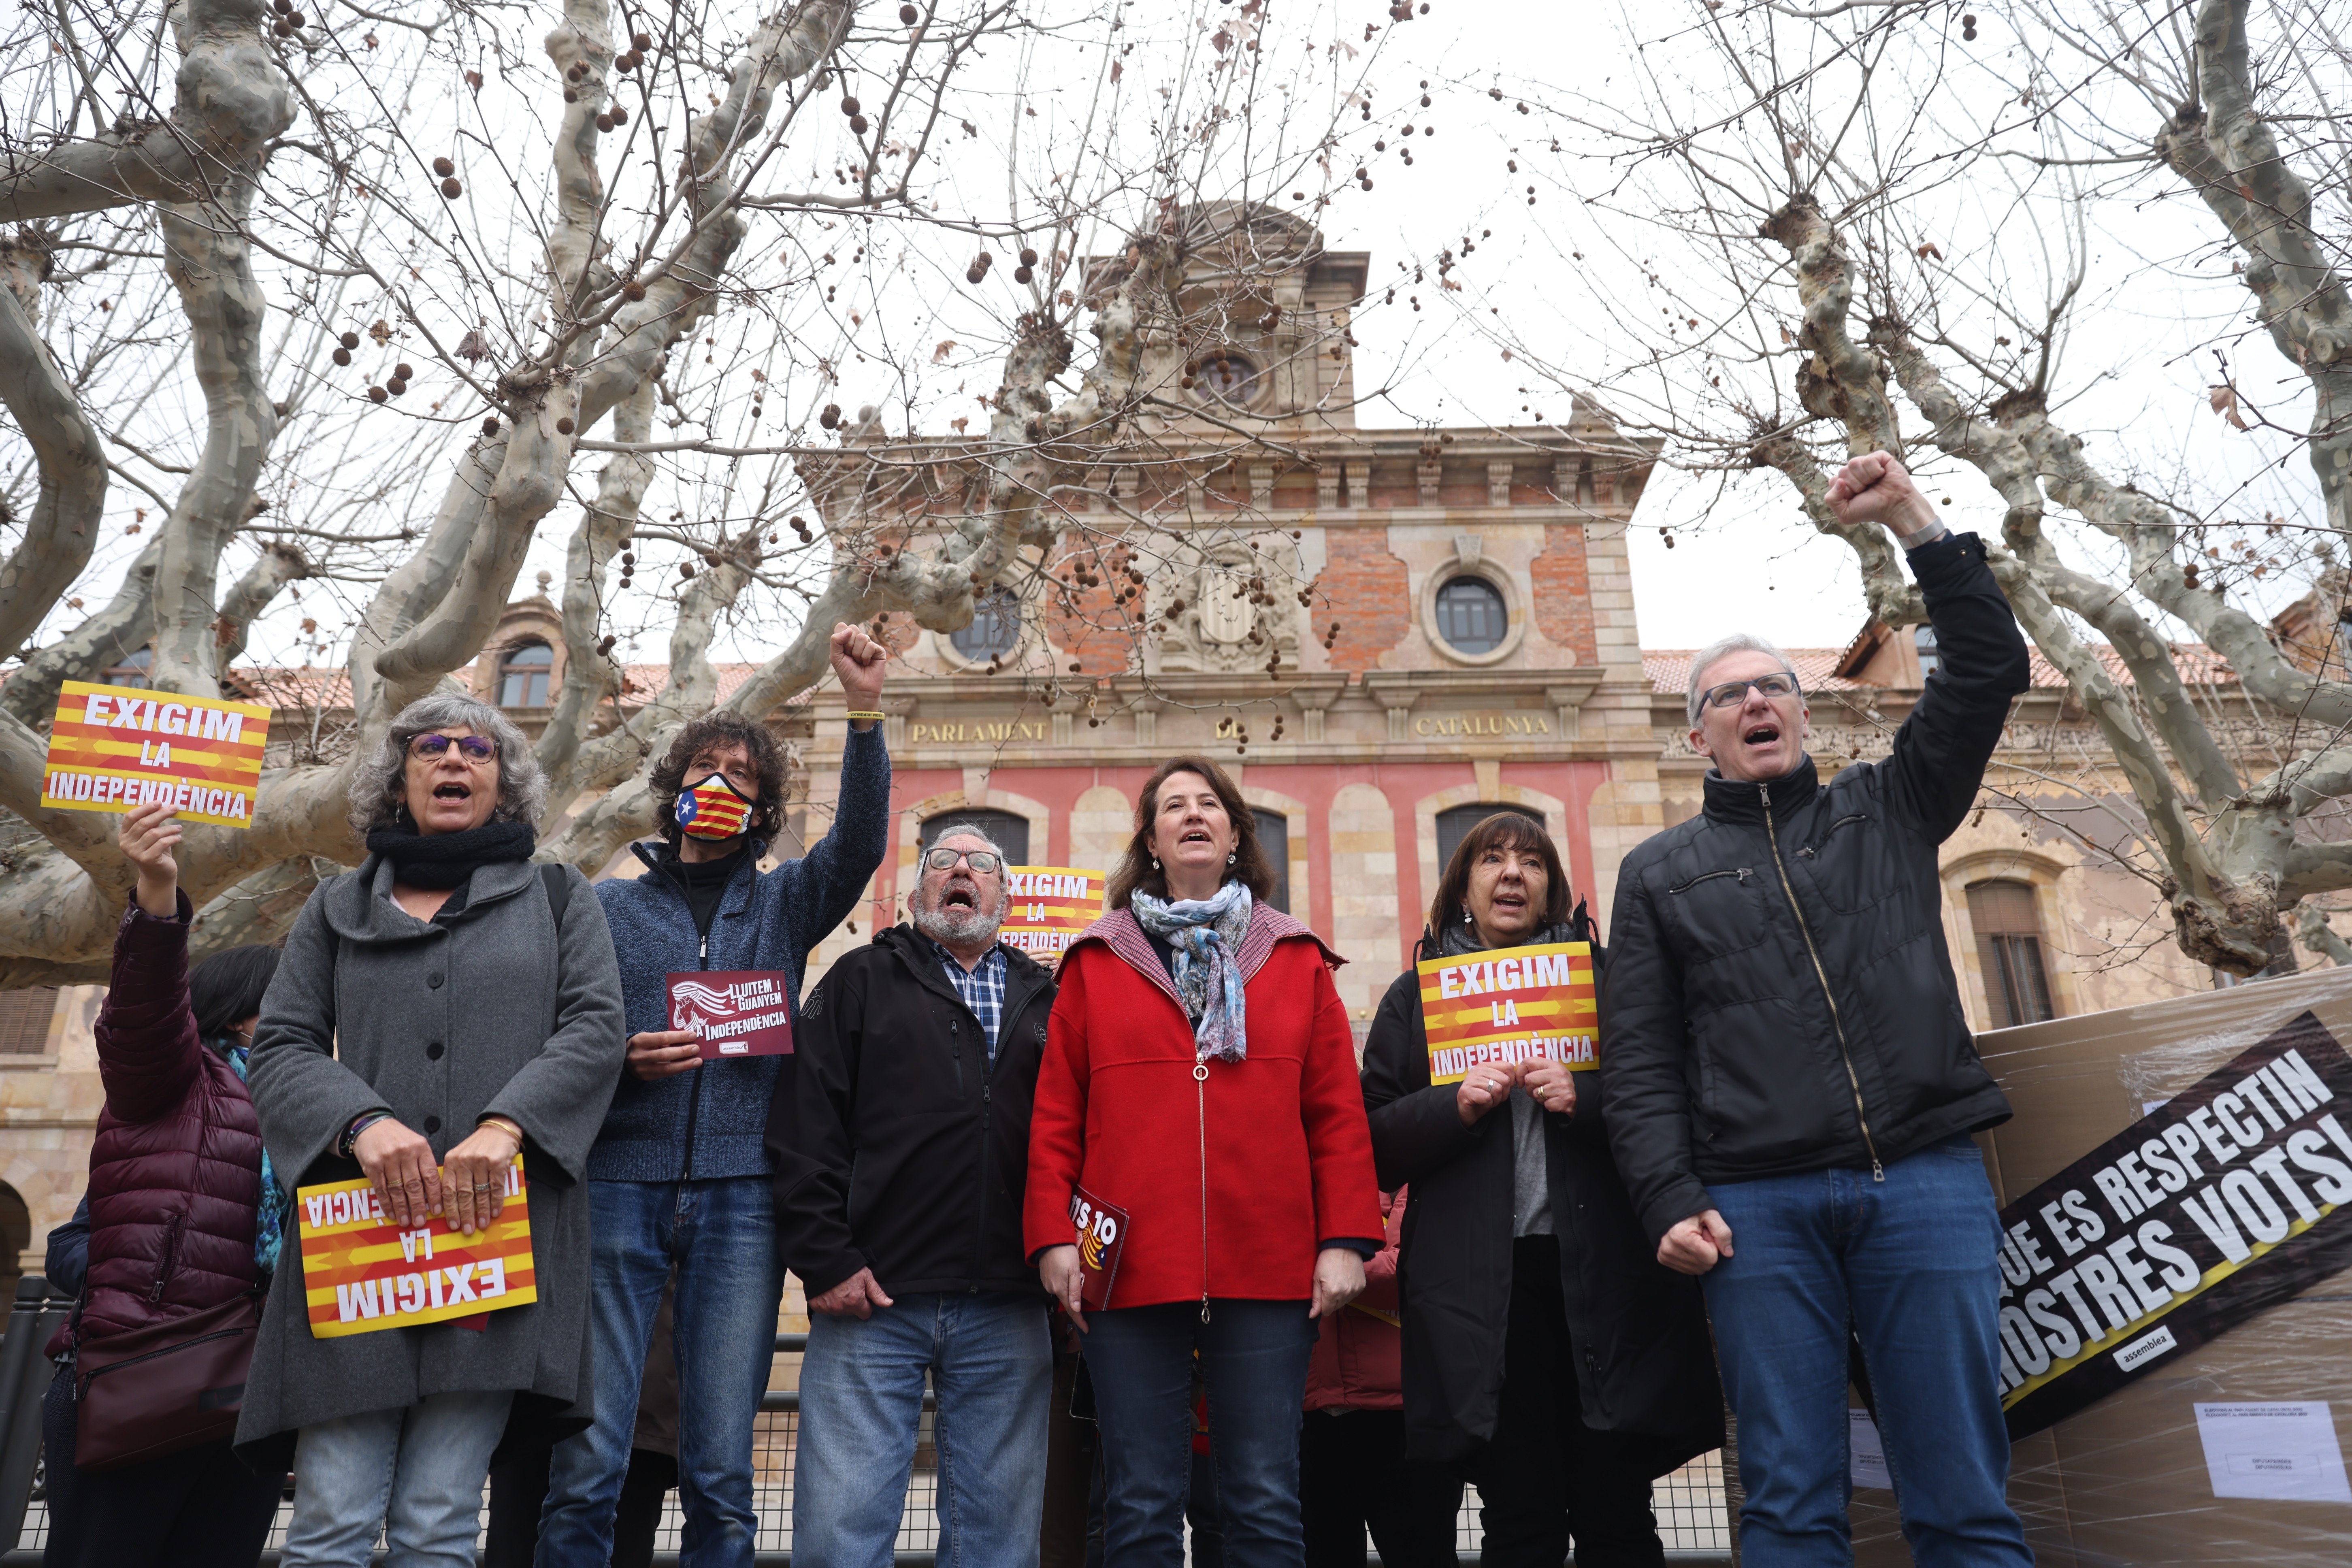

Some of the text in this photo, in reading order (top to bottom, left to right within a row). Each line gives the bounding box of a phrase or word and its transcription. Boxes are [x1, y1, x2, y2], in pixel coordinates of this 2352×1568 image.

[83, 694, 243, 743] EXIGIM
[912, 722, 1046, 743] PARLAMENT
[139, 740, 170, 768] LA
[48, 771, 245, 820] INDEPENDÈNCIA
[1008, 873, 1087, 899] XIGIM
[1027, 903, 1045, 921] LA
[729, 979, 780, 999] LLUITEM I
[1439, 954, 1570, 999] EXIGIM
[738, 992, 782, 1011] GUANYEM
[1491, 999, 1519, 1027] LA
[705, 1011, 786, 1041] INDEPENDÈNCIA
[1433, 1031, 1594, 1077] INDEPENDÈNCIA
[2039, 1189, 2105, 1257] ES
[2092, 1048, 2334, 1224] RESPECTIN
[399, 1229, 432, 1263] LA
[337, 1258, 506, 1323] EXIGIM
[2124, 1336, 2167, 1362] assemblea
